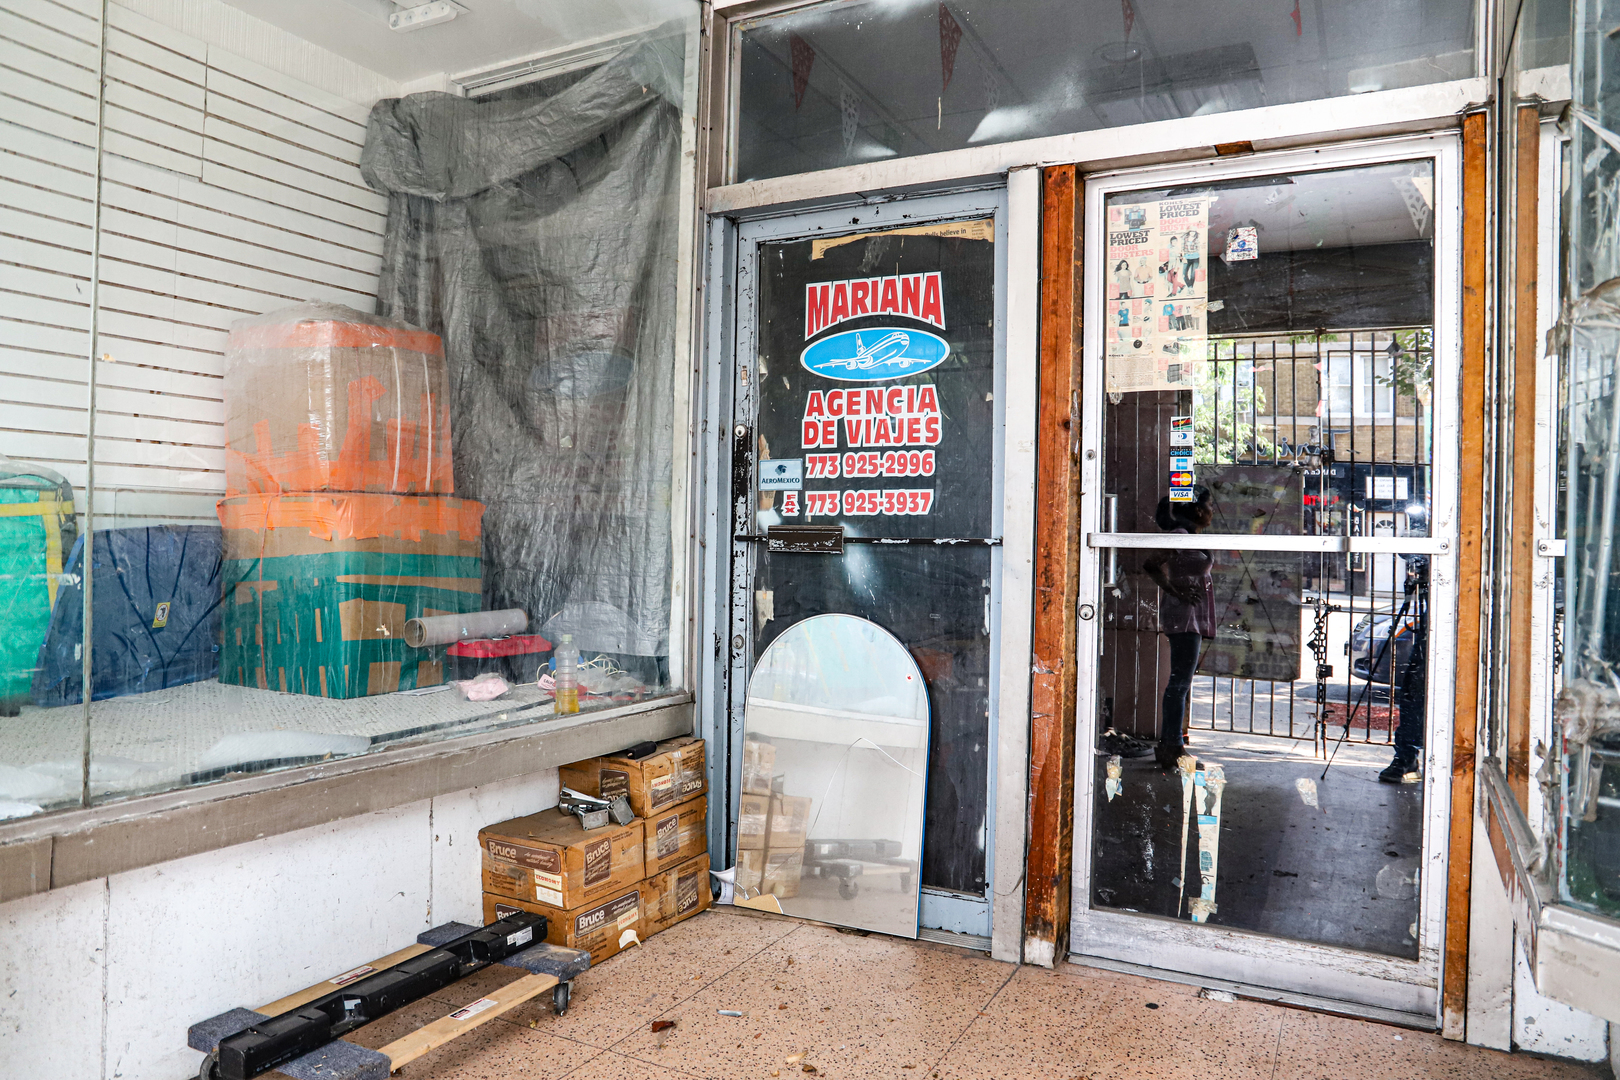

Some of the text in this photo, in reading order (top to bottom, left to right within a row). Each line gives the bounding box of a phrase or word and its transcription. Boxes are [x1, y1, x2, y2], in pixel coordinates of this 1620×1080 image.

[1160, 203, 1201, 212] LOWEST
[1160, 209, 1200, 219] PRICED
[1160, 217, 1189, 225] DOOR
[940, 229, 960, 237] believe
[1110, 230, 1150, 239] LOWEST
[1110, 237, 1148, 246] PRICED
[1110, 244, 1139, 252] DOOR
[1110, 249, 1154, 258] BUSTERS
[806, 273, 945, 339] MARIANA
[805, 385, 940, 418] AGENCIA
[803, 416, 941, 446] DE VIAJES
[806, 451, 935, 477] 773 925-2996
[783, 492, 798, 515] FAX
[805, 490, 934, 515] 773 925-3937
[657, 818, 677, 839] Bruce
[489, 841, 517, 859] Bruce
[586, 841, 610, 864] Bruce
[535, 874, 561, 886] ECONOMY
[678, 890, 698, 912] Bruce
[496, 909, 520, 921] Bru
[579, 909, 605, 930] Bruce
